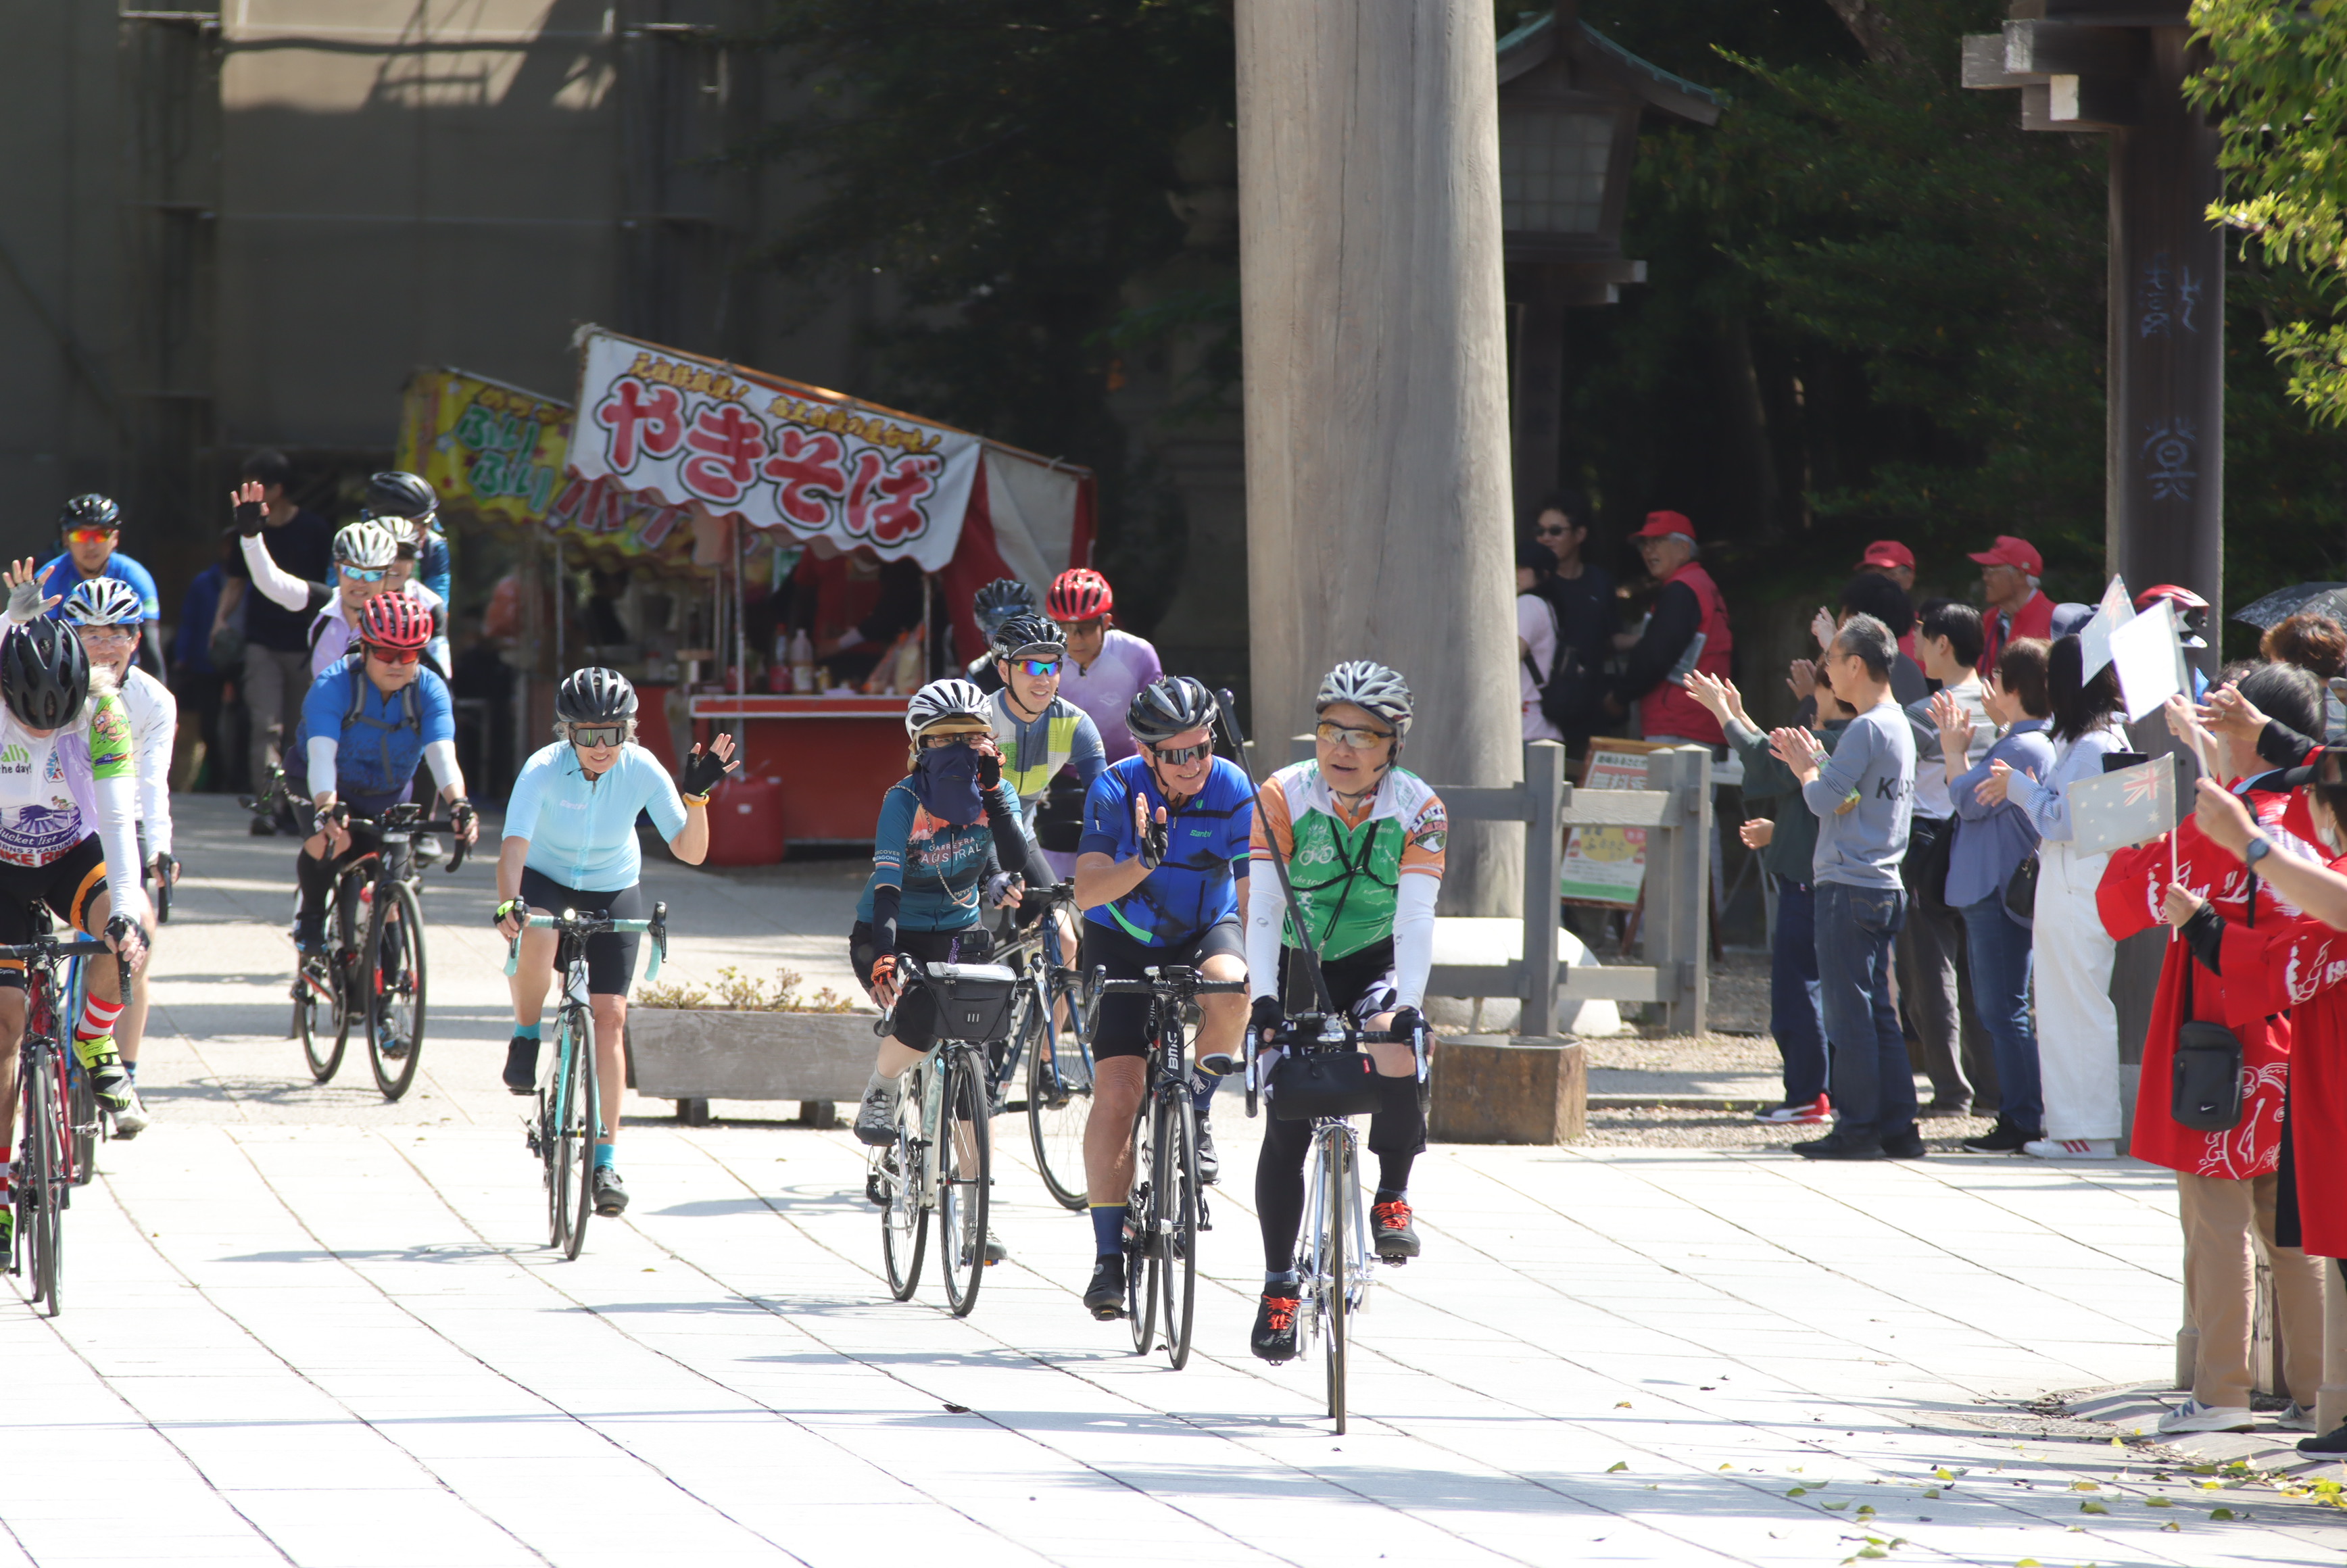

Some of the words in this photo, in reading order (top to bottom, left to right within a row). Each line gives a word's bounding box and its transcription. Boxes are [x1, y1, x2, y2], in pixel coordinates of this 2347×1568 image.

[596, 376, 944, 545] やきそば
[16, 762, 32, 775] day!
[38, 835, 58, 846] list
[920, 843, 982, 864] AUSTRAL
[1167, 1031, 1178, 1070] BMC
